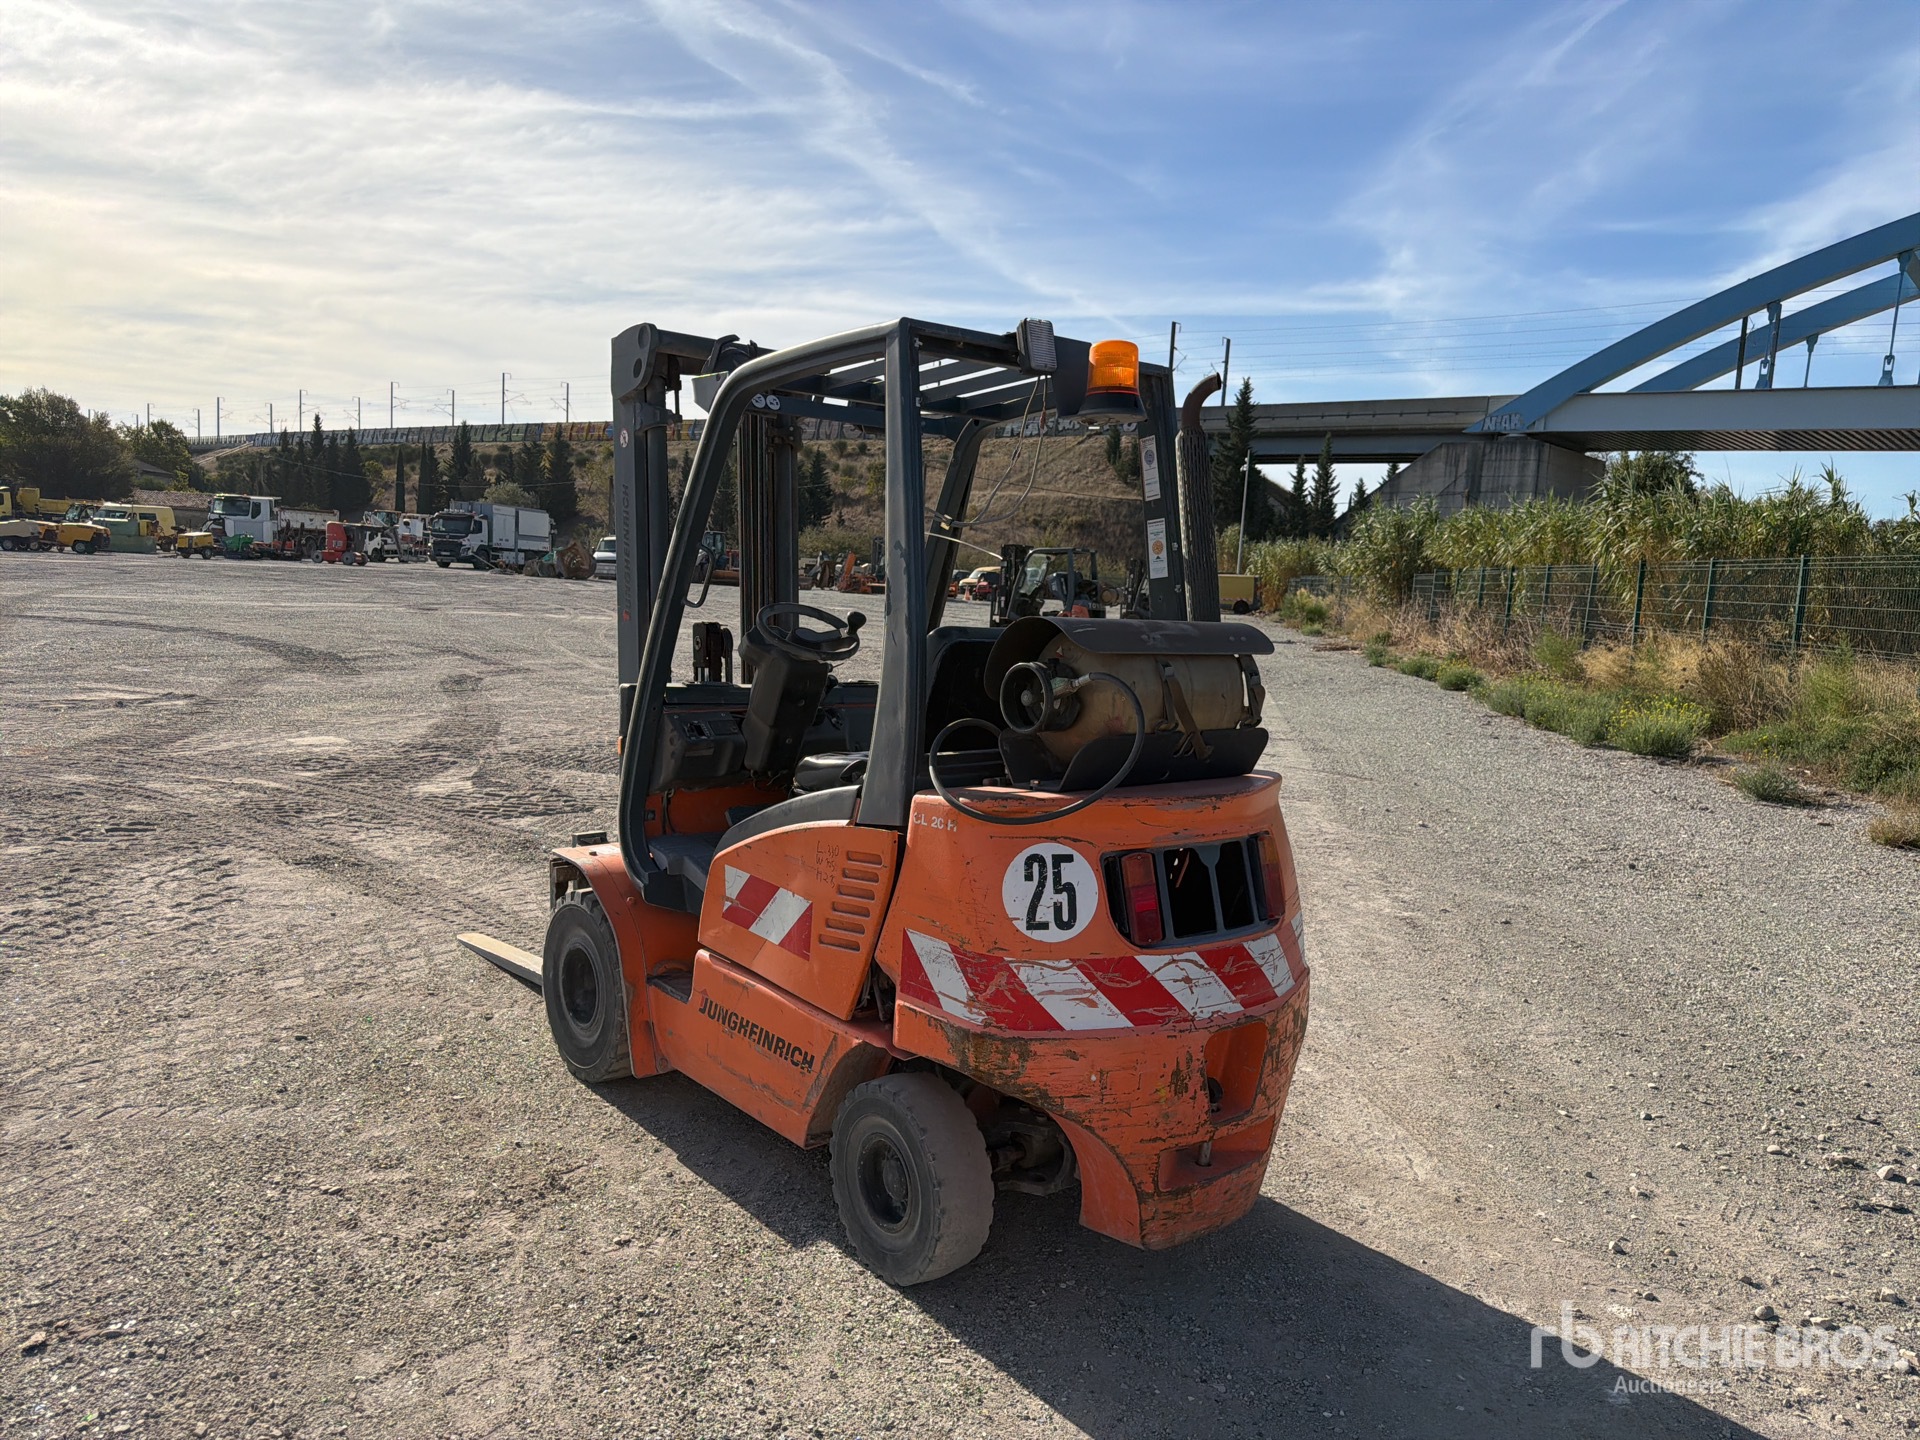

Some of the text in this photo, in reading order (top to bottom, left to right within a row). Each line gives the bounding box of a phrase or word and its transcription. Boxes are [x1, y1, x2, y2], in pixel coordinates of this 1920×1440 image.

[622, 484, 631, 622] JUNGHEINRICH
[1024, 853, 1077, 931] 25
[698, 992, 815, 1074] JUNGHEINRICH
